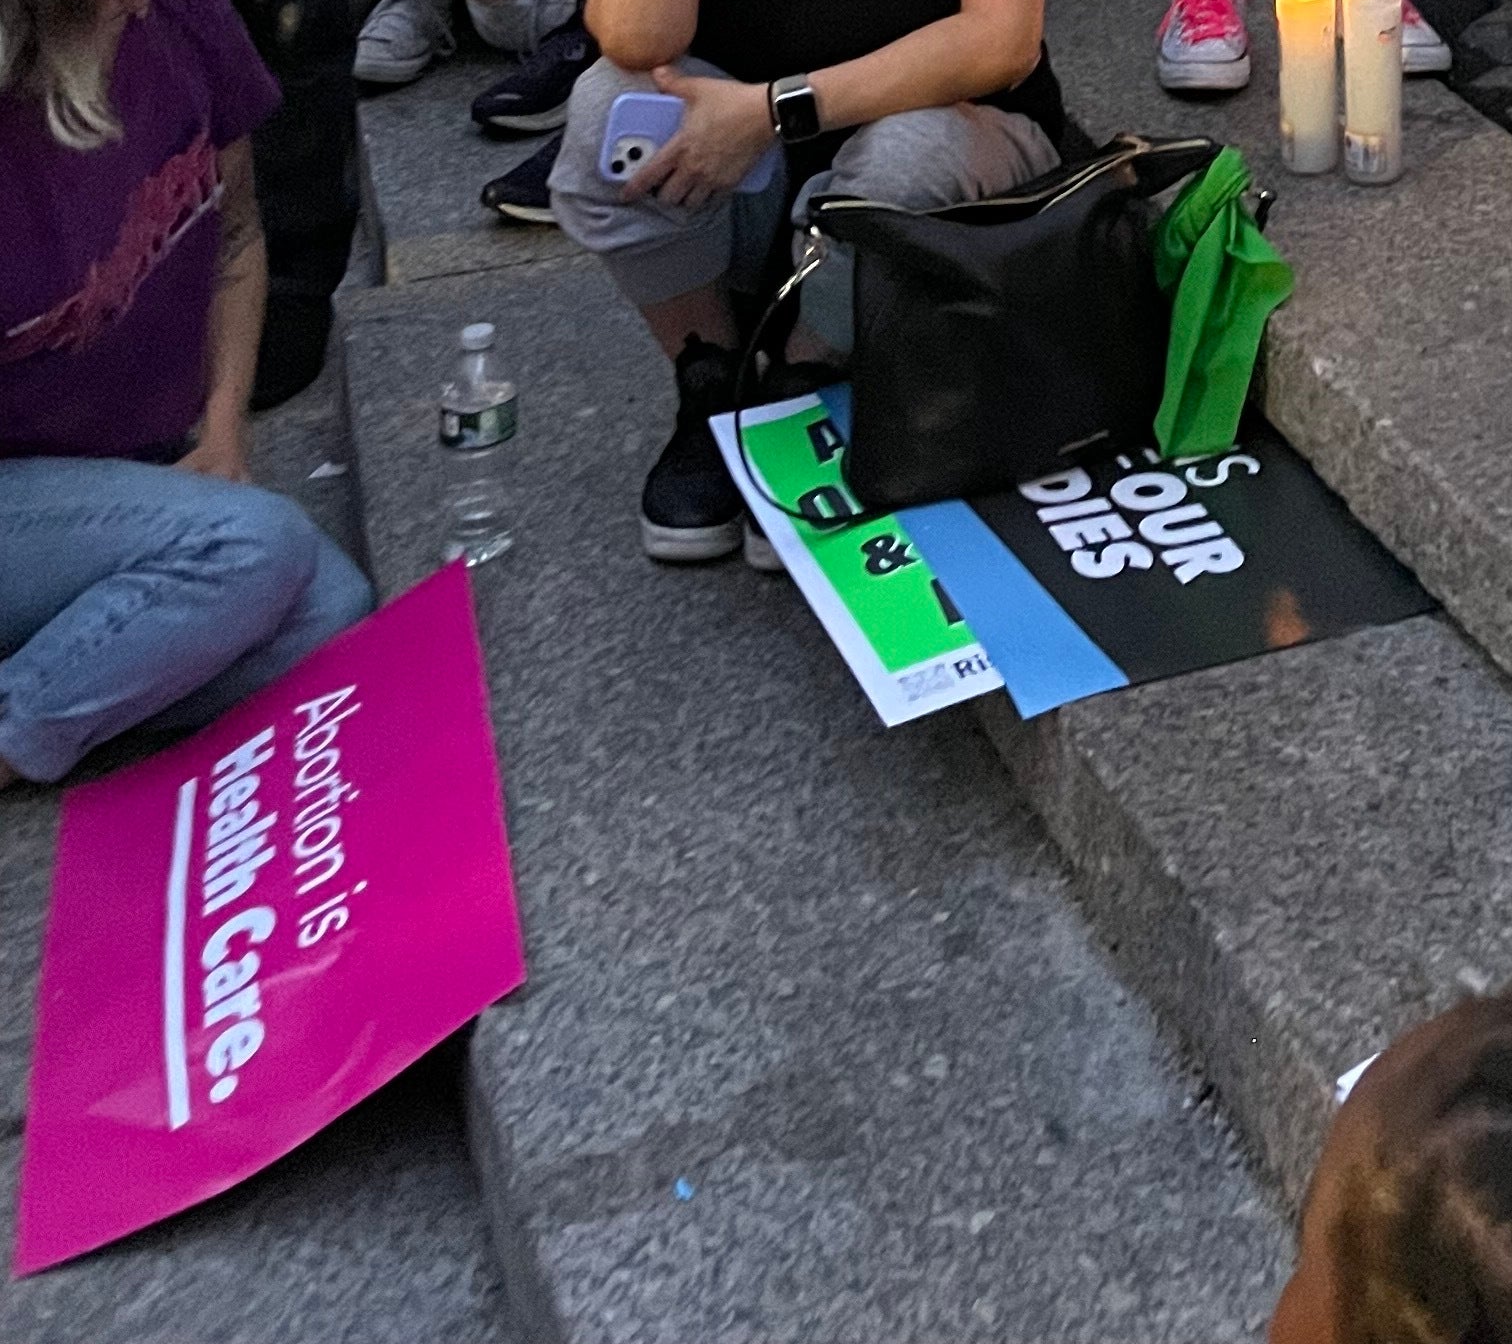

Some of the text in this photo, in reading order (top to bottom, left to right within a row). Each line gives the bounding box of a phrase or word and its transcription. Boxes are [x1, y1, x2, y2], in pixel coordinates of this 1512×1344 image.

[1110, 471, 1245, 586] OUR
[201, 724, 279, 1105] Health Care.
[292, 684, 368, 949] Abortion is
